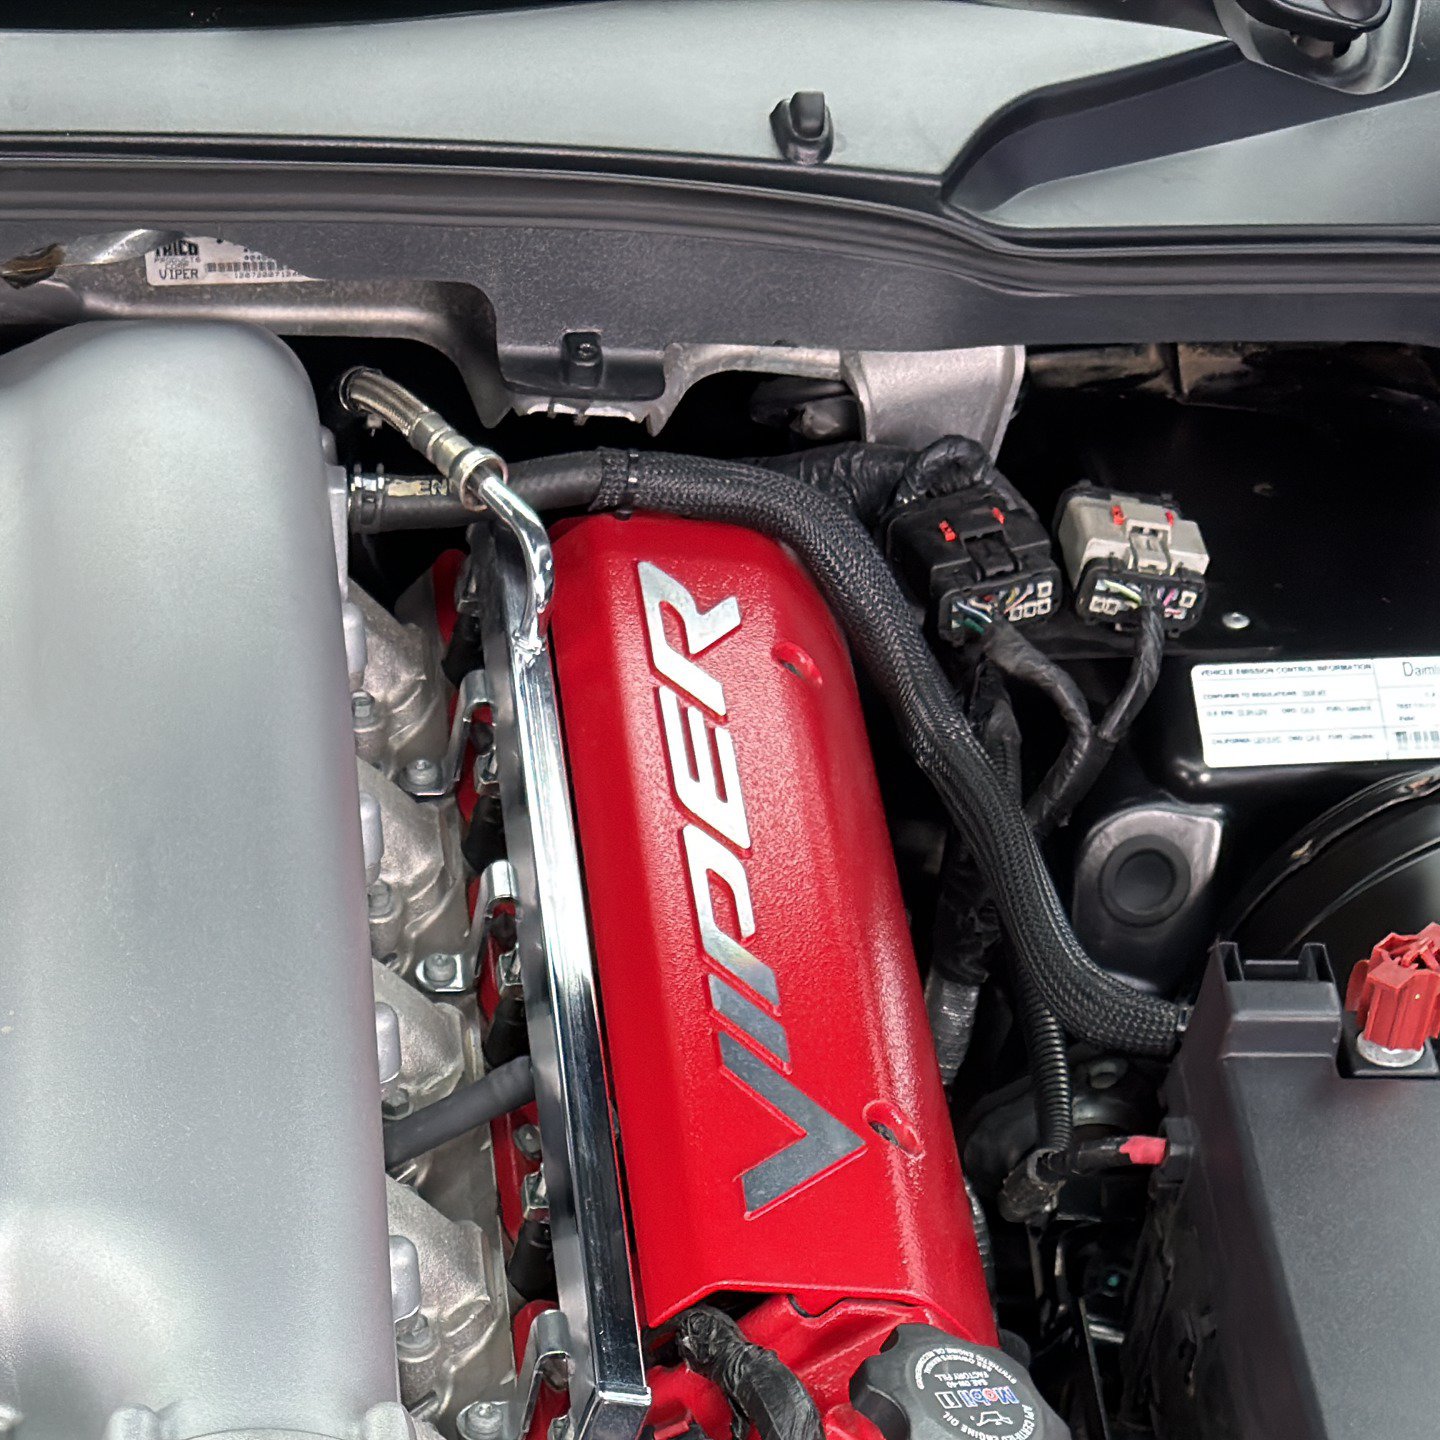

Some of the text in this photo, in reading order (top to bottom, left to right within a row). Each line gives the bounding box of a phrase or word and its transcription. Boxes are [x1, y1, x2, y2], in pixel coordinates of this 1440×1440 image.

[159, 269, 198, 280] VIPER
[637, 561, 867, 1216] VIPER
[957, 1386, 1020, 1407] Mobil
[942, 1411, 959, 1427] OIL
